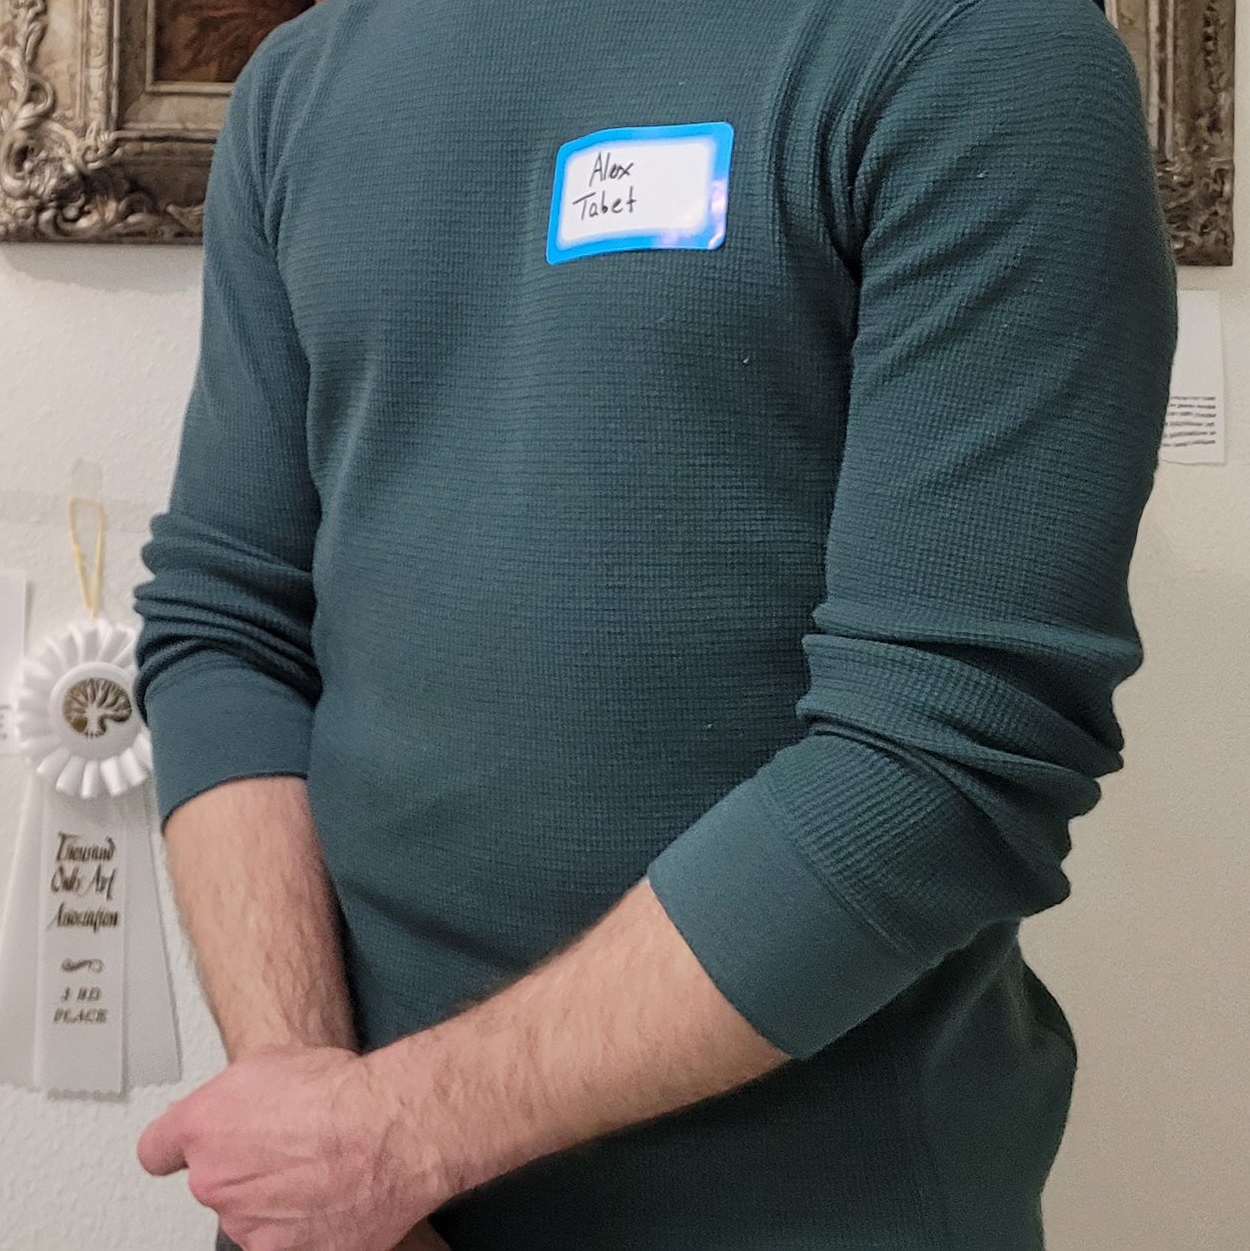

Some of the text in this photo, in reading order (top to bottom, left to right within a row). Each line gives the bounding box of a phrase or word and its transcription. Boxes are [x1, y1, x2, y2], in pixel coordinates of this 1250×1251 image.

[588, 151, 634, 187] Alex
[572, 185, 637, 220] Tabet
[56, 831, 117, 862] Thousand
[50, 862, 117, 901] Oaks Art
[46, 902, 119, 933] Association
[53, 1008, 108, 1023] PLACE
